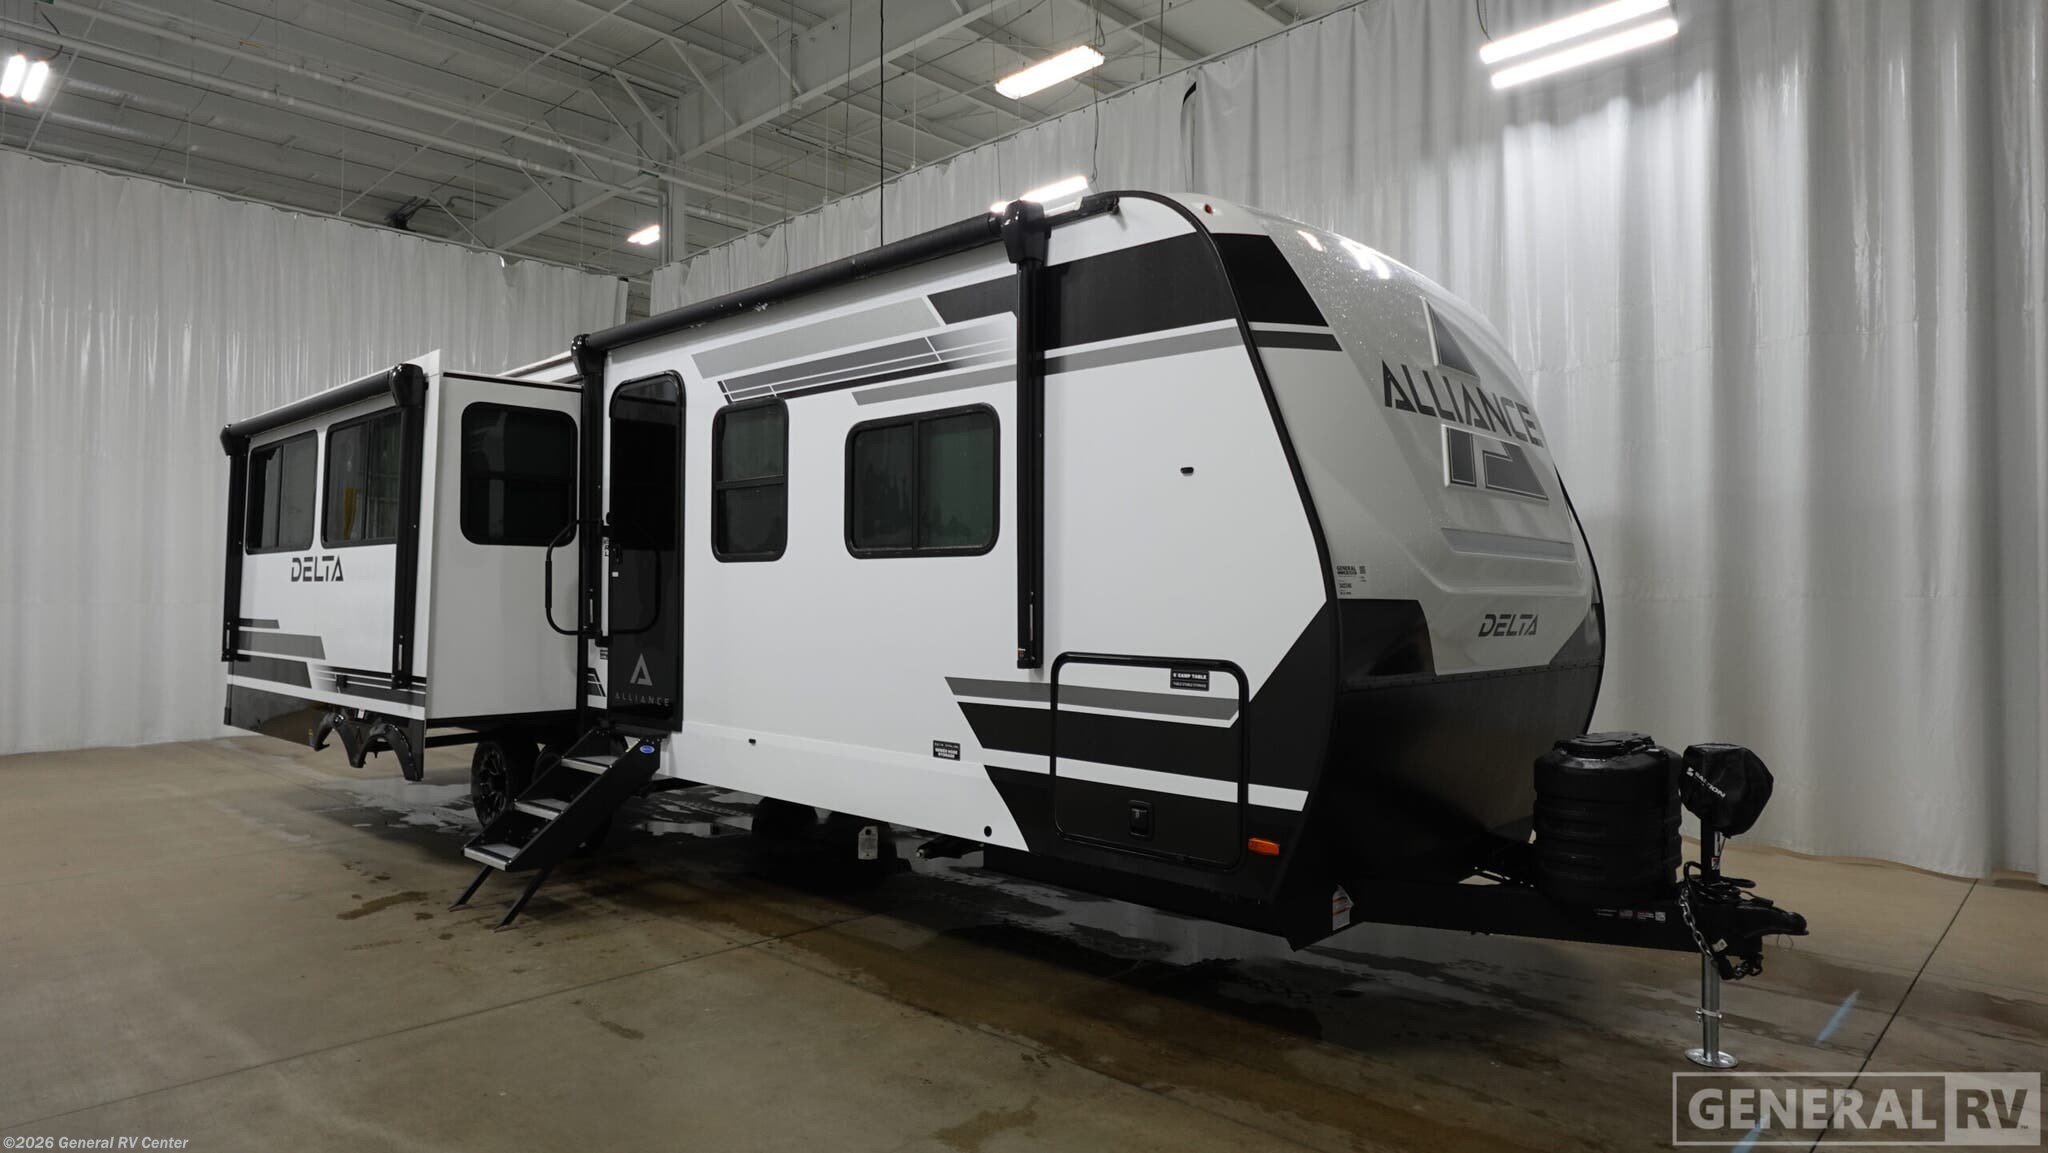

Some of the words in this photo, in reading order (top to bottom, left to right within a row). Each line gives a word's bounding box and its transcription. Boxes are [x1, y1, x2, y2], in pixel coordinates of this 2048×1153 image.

[1382, 360, 1544, 448] ALLIANCE
[291, 555, 344, 582] DELTA
[1478, 614, 1538, 637] DELTA
[615, 692, 670, 707] ALLIANCE
